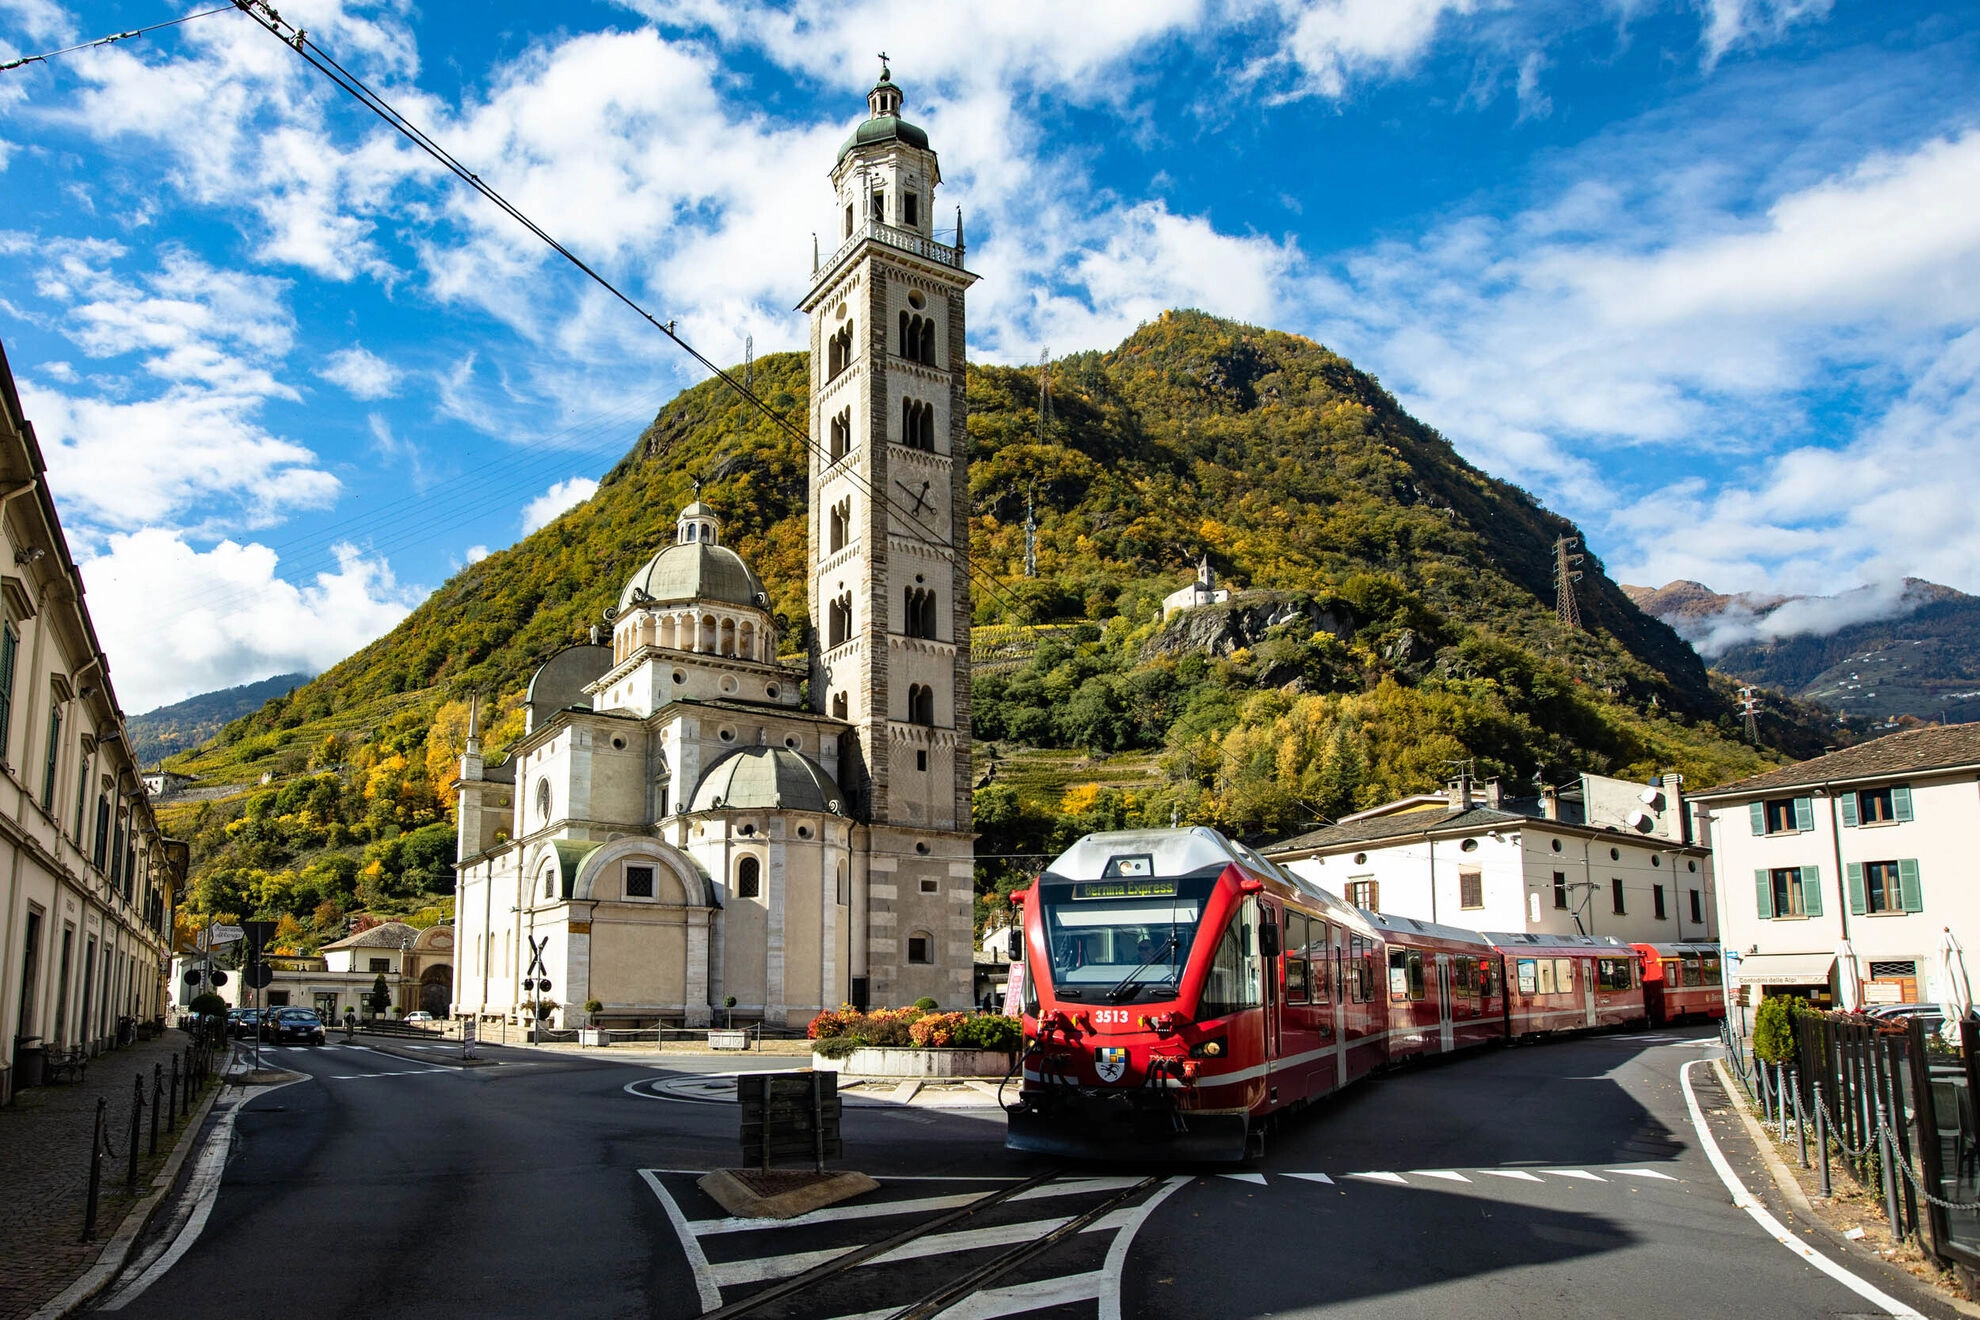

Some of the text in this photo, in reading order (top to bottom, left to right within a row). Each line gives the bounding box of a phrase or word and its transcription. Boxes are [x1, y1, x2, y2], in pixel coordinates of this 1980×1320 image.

[1085, 881, 1173, 896] Bernina Express
[1095, 1010, 1129, 1023] 3513
